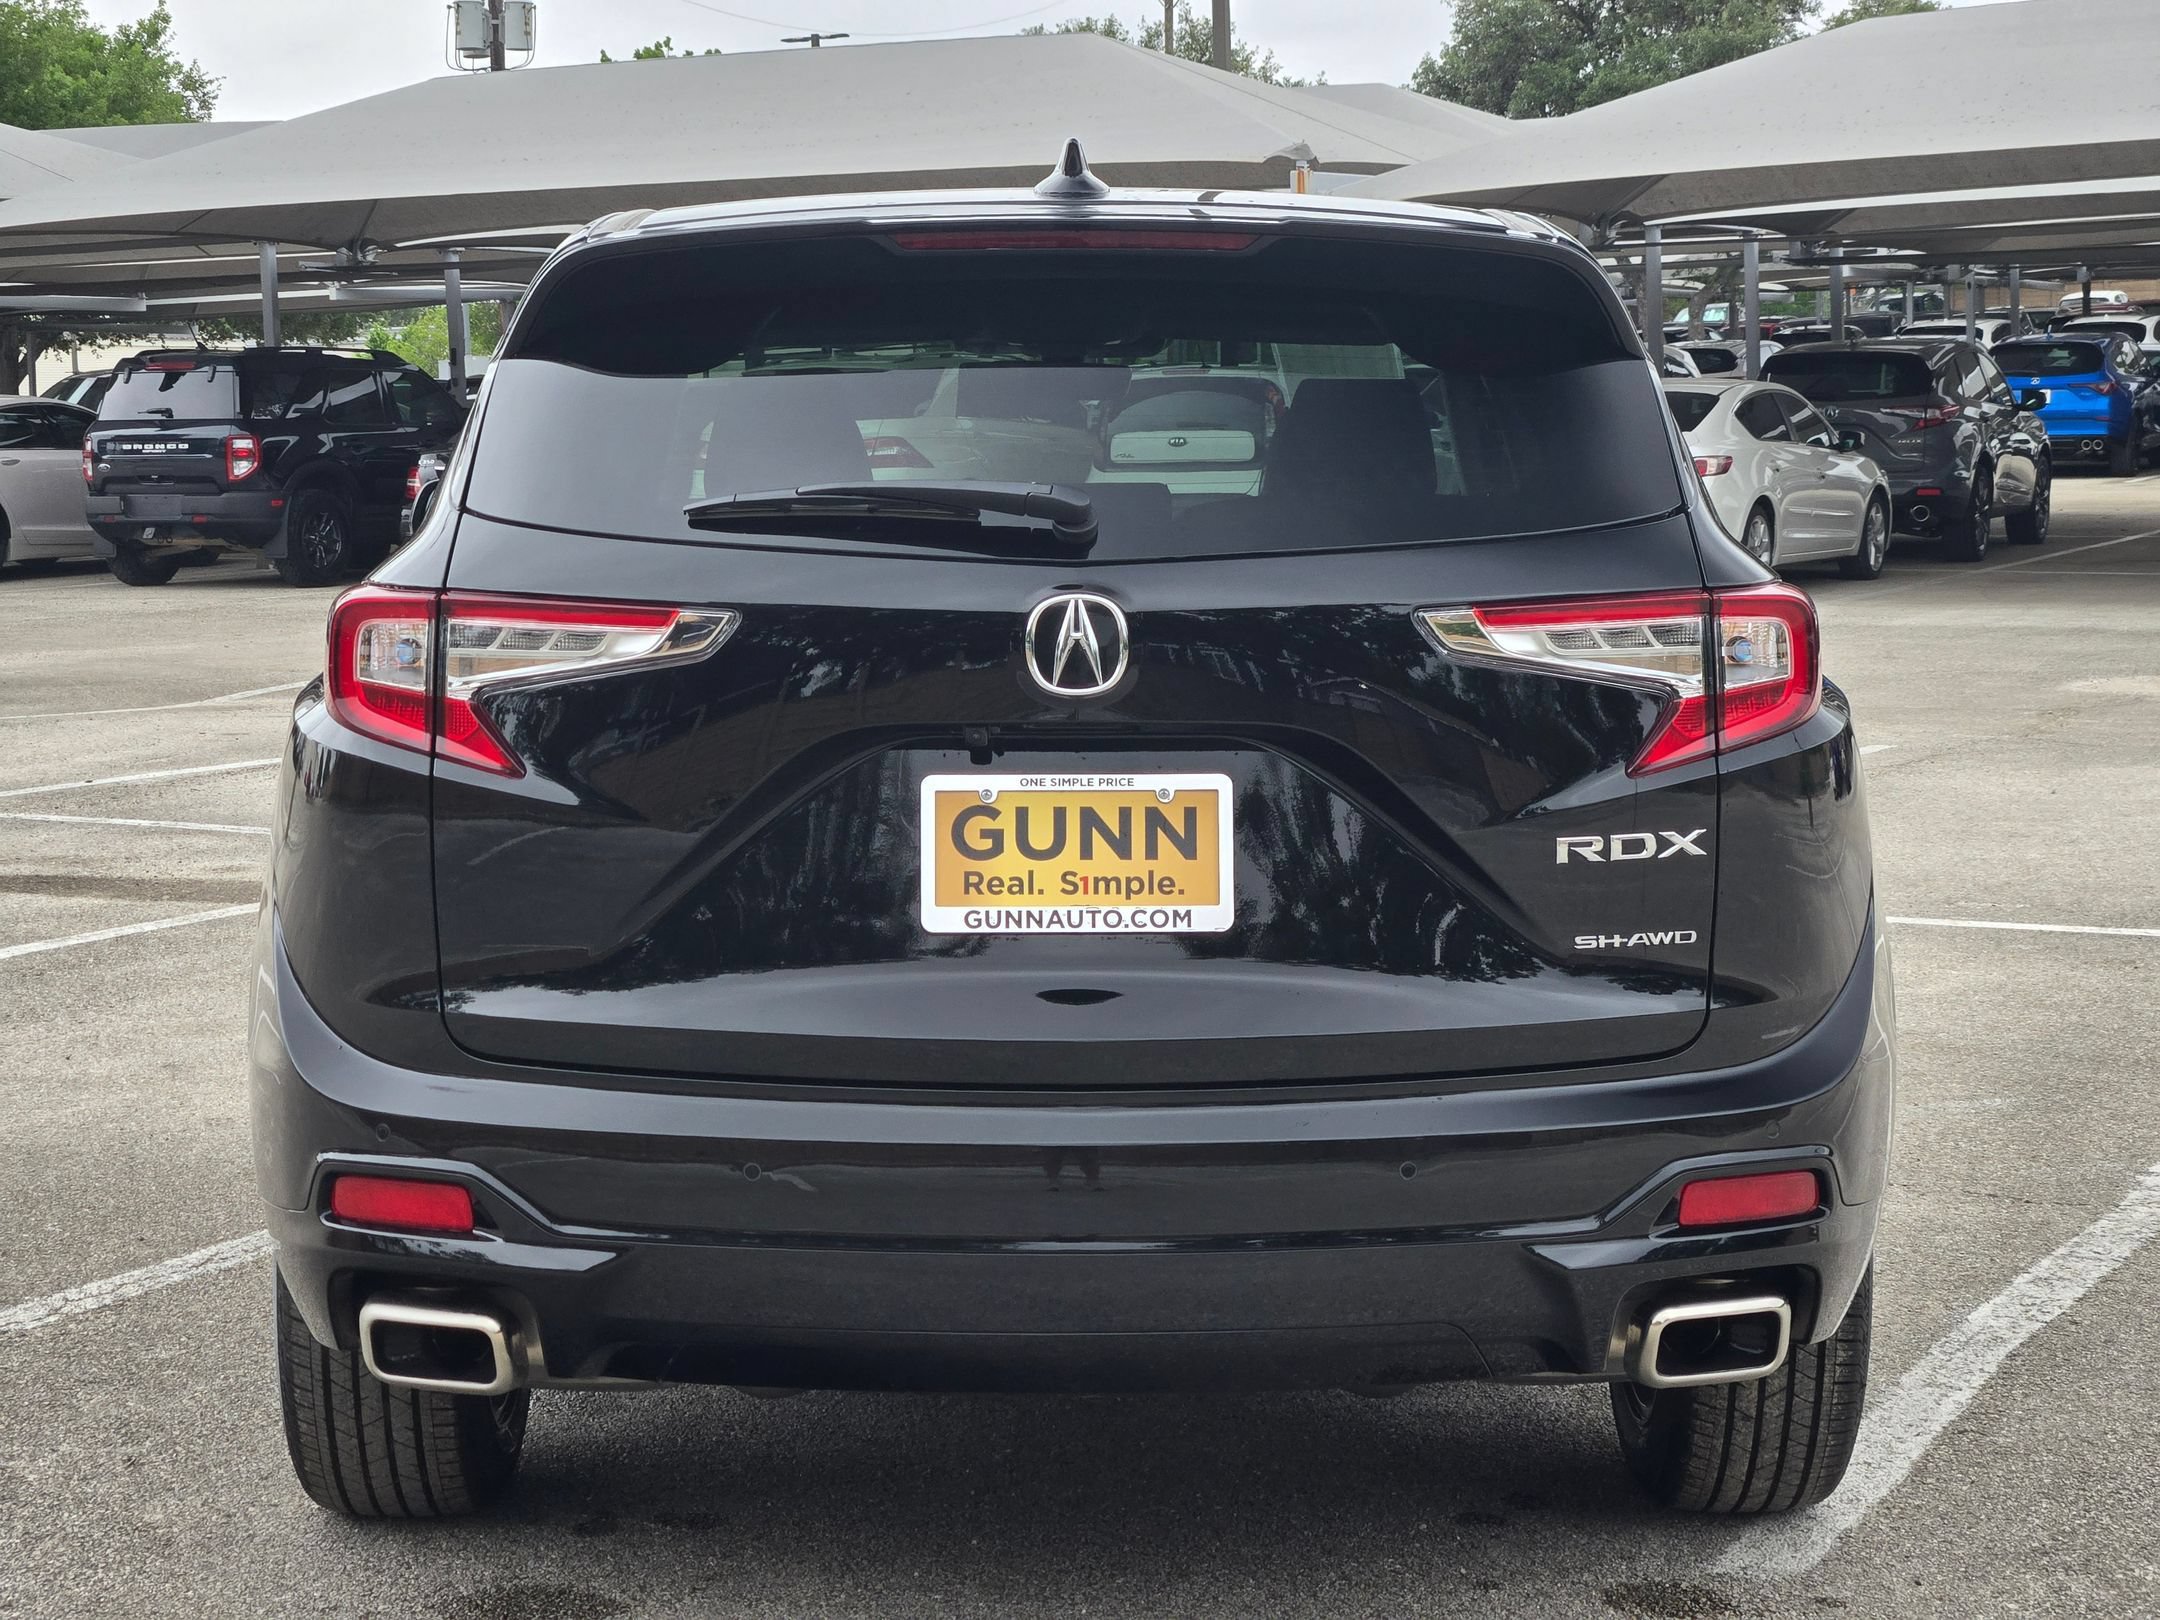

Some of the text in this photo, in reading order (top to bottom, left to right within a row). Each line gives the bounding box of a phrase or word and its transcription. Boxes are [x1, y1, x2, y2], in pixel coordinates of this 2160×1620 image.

[1019, 777, 1135, 787] ONE SIMPLE PRICE
[951, 804, 1198, 861] GUNN
[1555, 828, 1708, 865] RDX
[963, 869, 1185, 900] Real. S1mple.
[964, 909, 1192, 929] GUNNAUTO.COM
